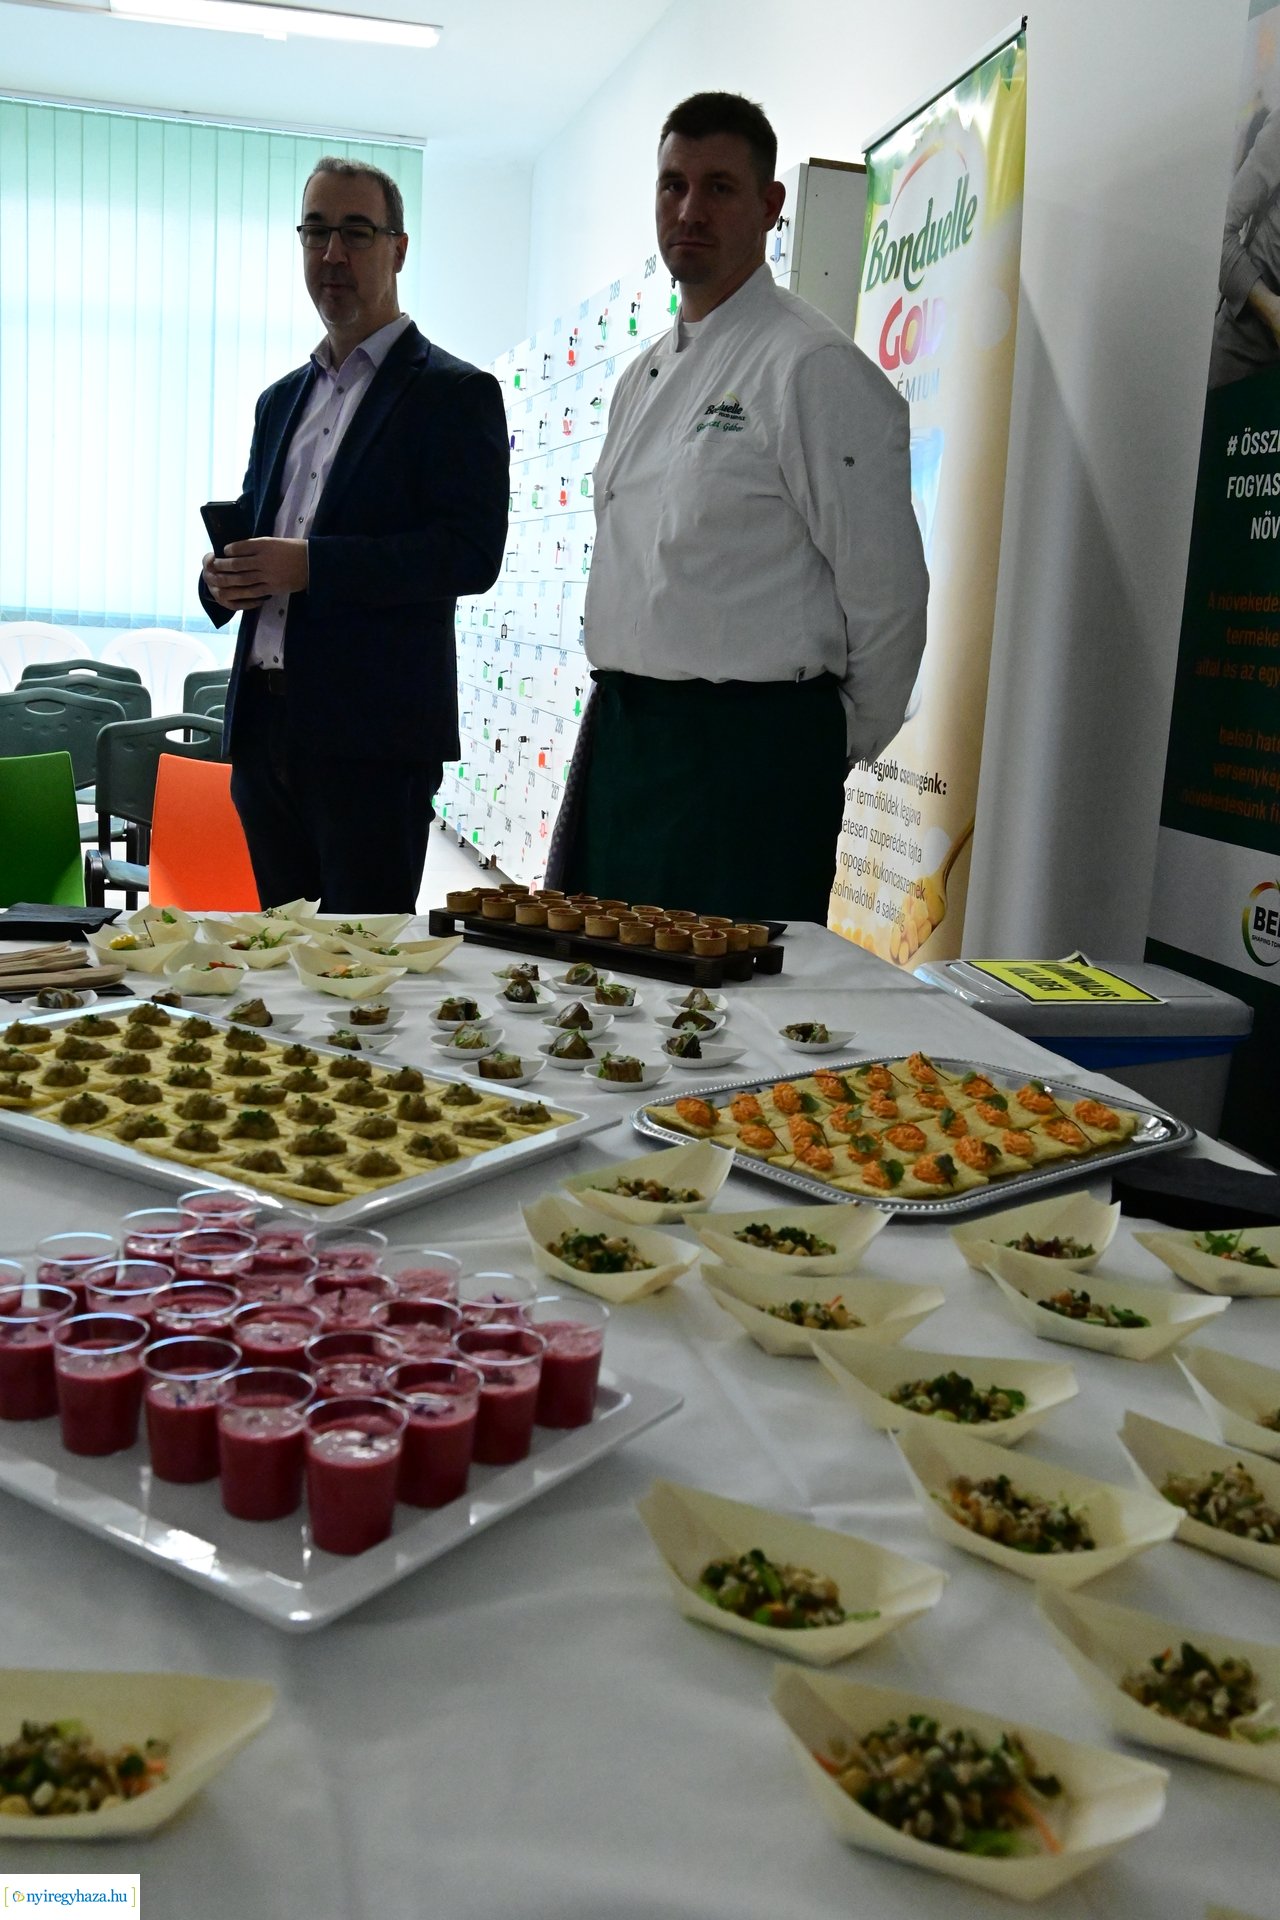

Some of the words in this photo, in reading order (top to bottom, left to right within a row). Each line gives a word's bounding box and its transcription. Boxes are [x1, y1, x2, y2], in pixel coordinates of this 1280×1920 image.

[864, 173, 978, 293] Bonduelle
[645, 254, 656, 279] 298
[879, 296, 947, 372] GOLD
[1227, 473, 1280, 499] FOGYAS
[1218, 592, 1280, 614] növekedé
[1225, 626, 1280, 648] terméke
[900, 768, 947, 795] csemegénk:
[841, 818, 868, 839] etesen
[870, 828, 907, 856] szuperédes
[873, 857, 925, 901] kukoricaszemek
[831, 880, 875, 911] solnivalótól
[876, 899, 881, 914] a
[1253, 906, 1280, 938] BE
